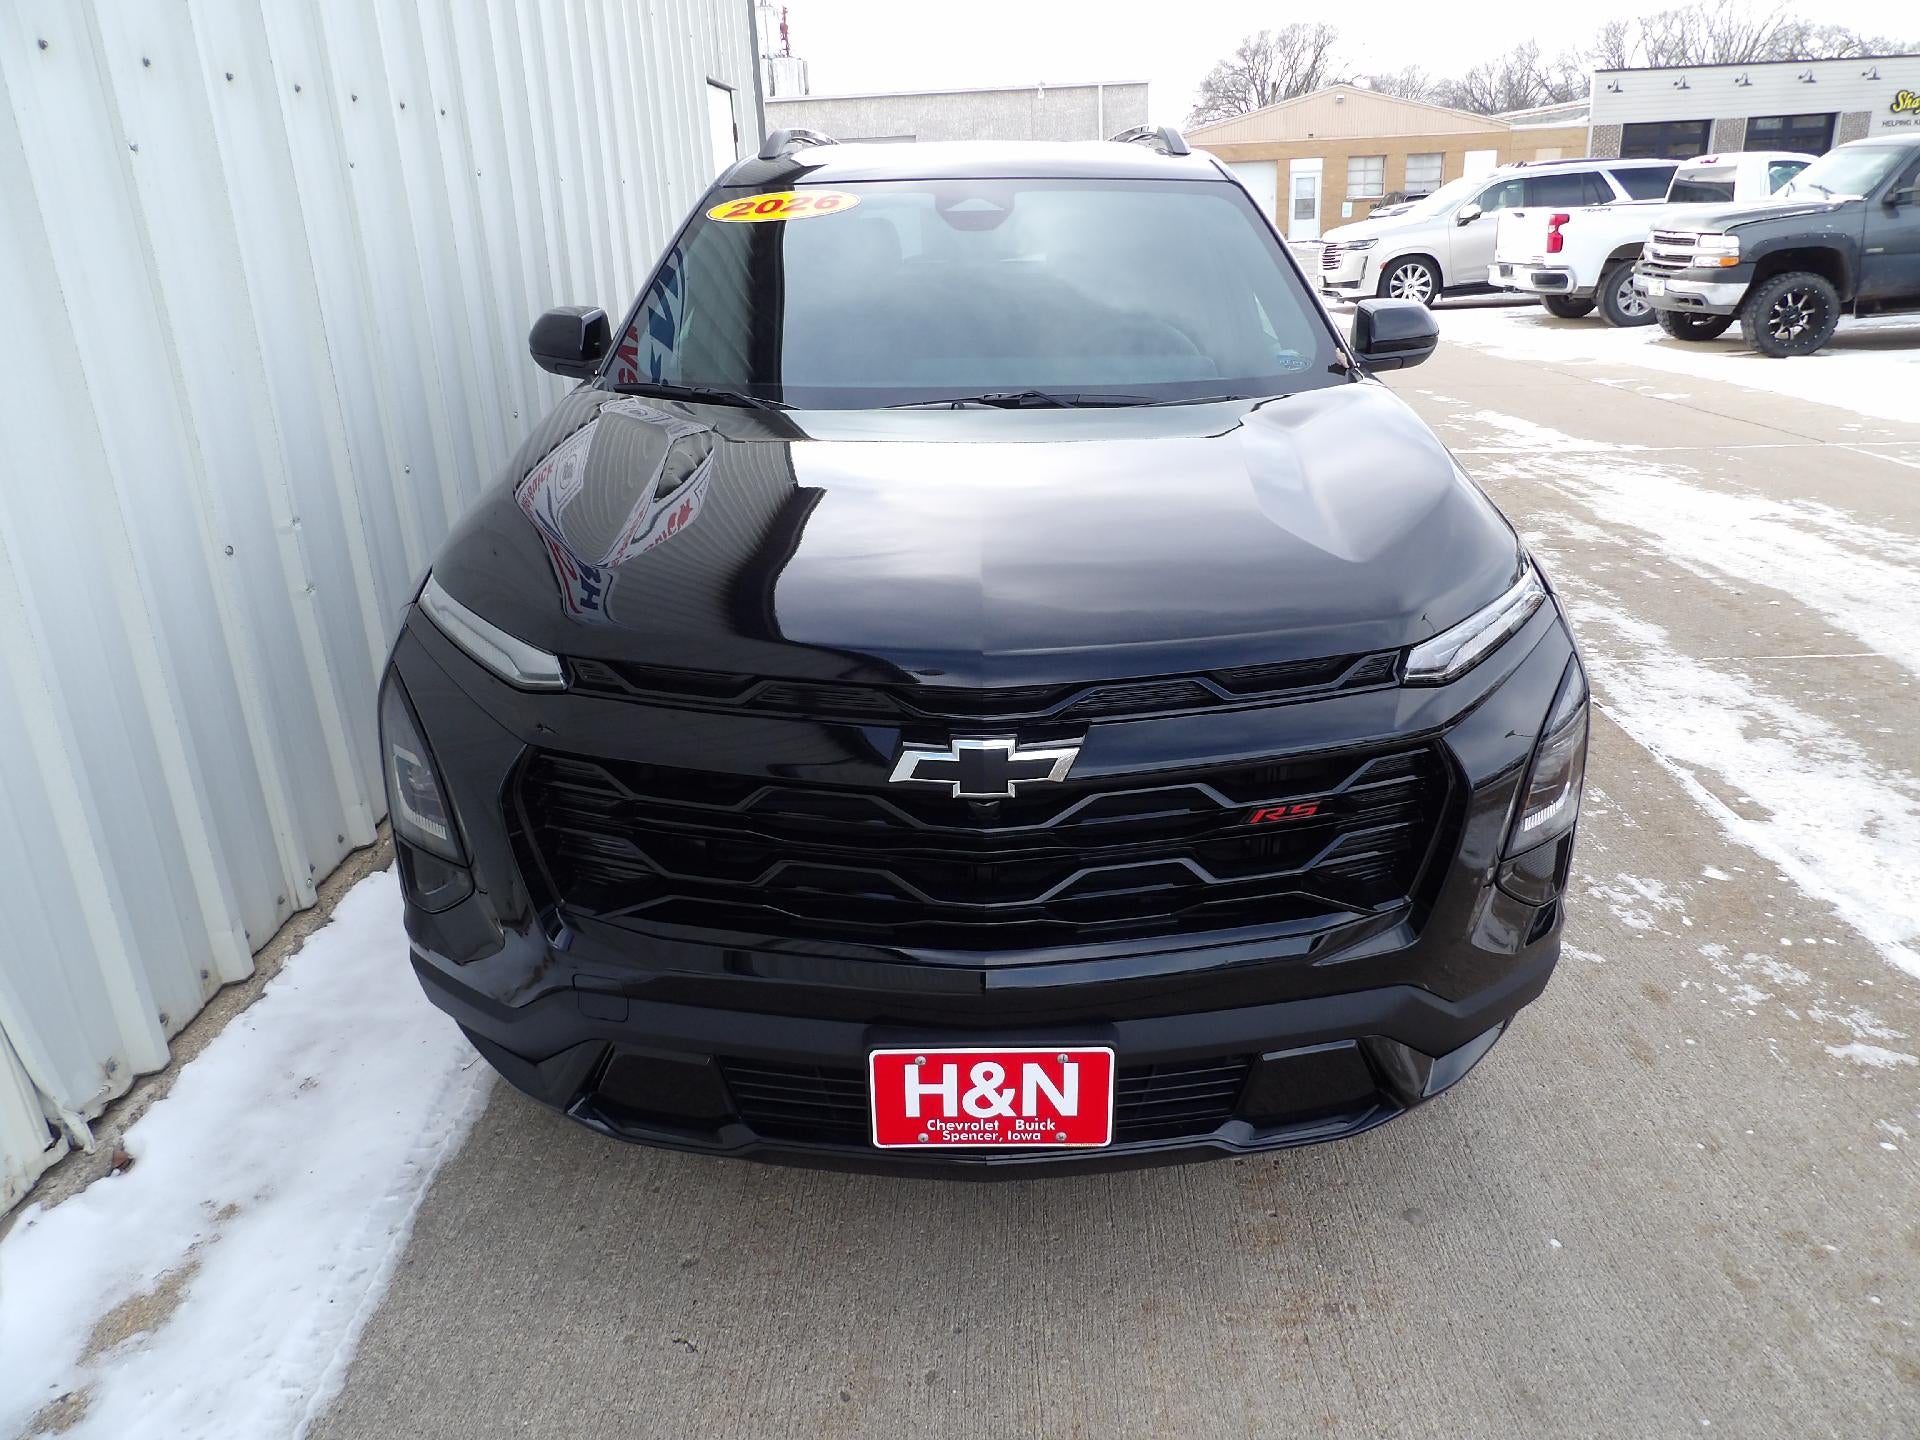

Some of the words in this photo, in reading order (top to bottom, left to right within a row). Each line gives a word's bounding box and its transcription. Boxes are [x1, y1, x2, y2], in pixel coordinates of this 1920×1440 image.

[1882, 119, 1911, 127] HELPING
[723, 195, 842, 218] 2026
[1250, 799, 1322, 824] RS
[904, 1061, 1079, 1118] H&N
[927, 1119, 999, 1131] Chevrolet
[1015, 1118, 1056, 1131] Buick
[942, 1130, 1003, 1142] Spencer,
[1007, 1131, 1041, 1141] Iowa
